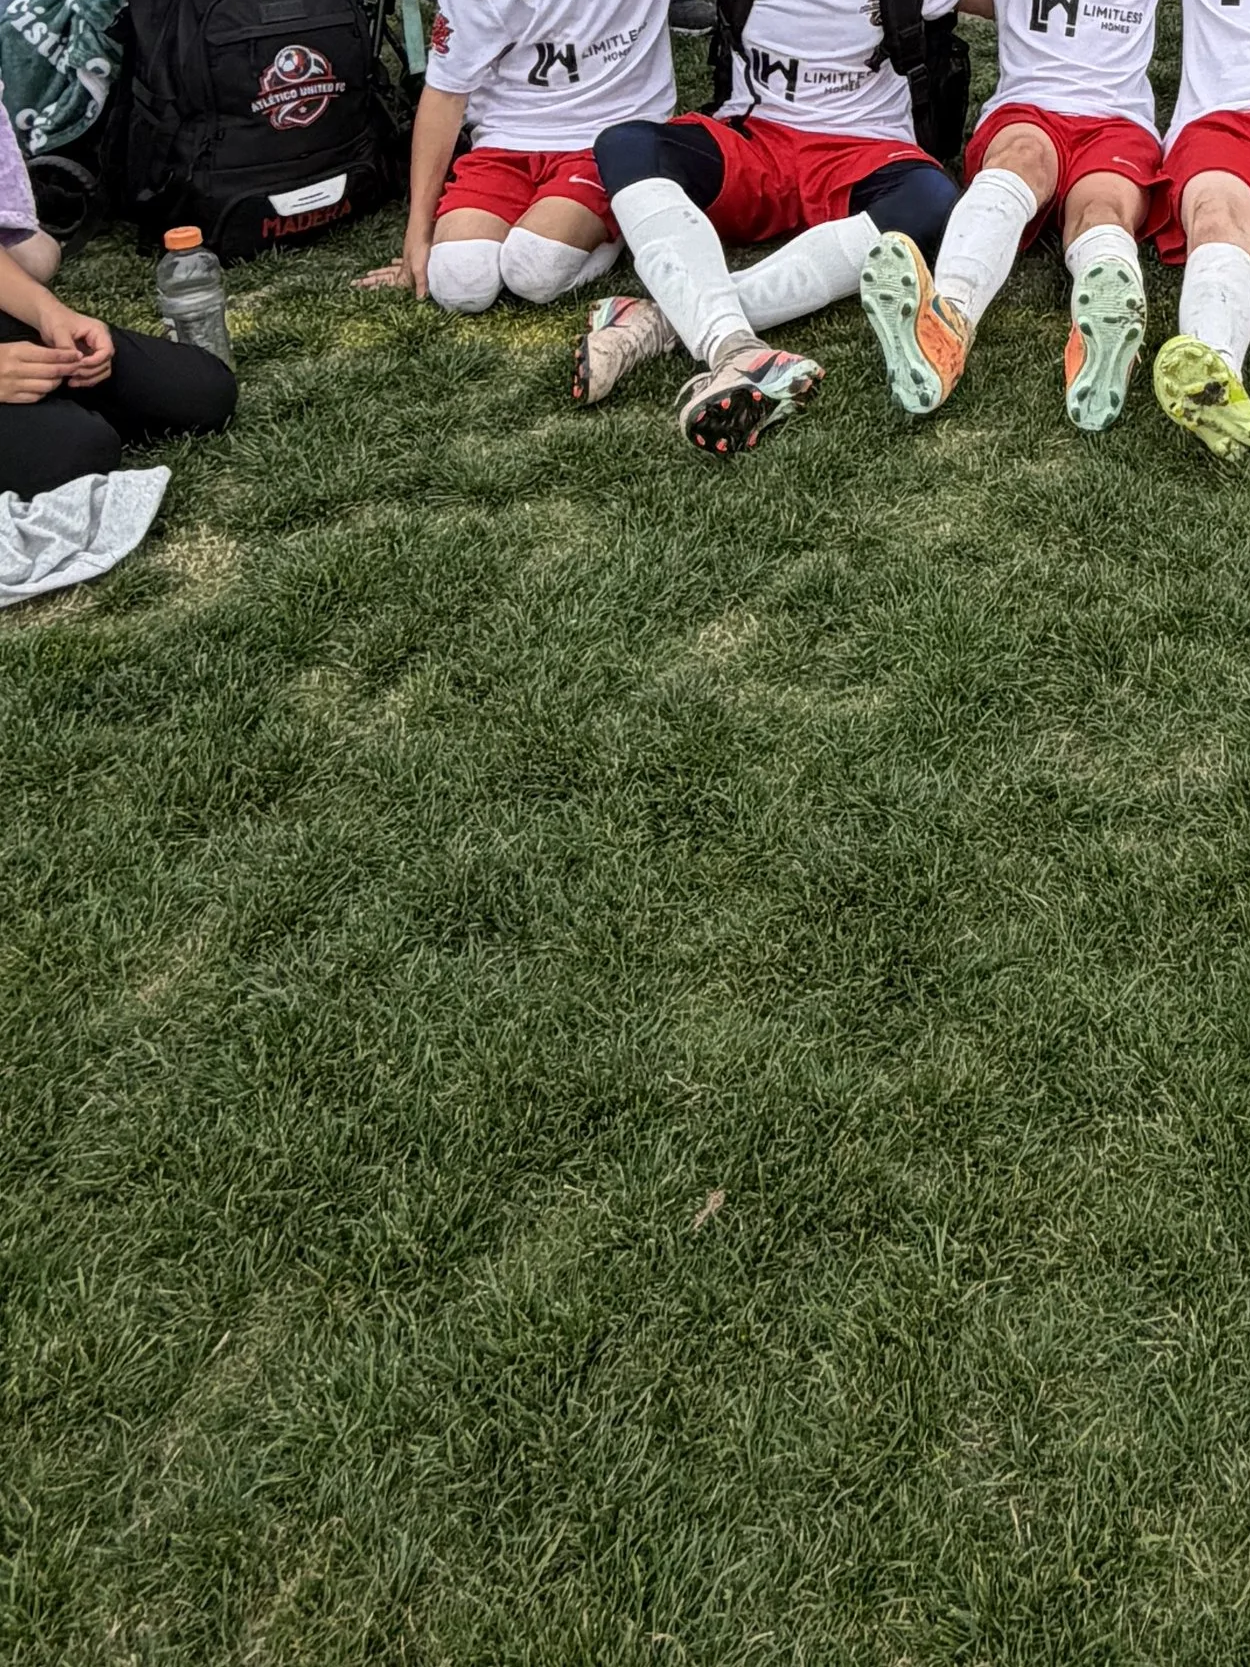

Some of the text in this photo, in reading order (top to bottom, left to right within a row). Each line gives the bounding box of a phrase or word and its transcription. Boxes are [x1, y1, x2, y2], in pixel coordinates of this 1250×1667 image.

[1083, 4, 1143, 24] LIMITLESS
[1101, 21, 1130, 34] HOMES
[300, 83, 334, 97] UNITED
[335, 82, 346, 92] FC
